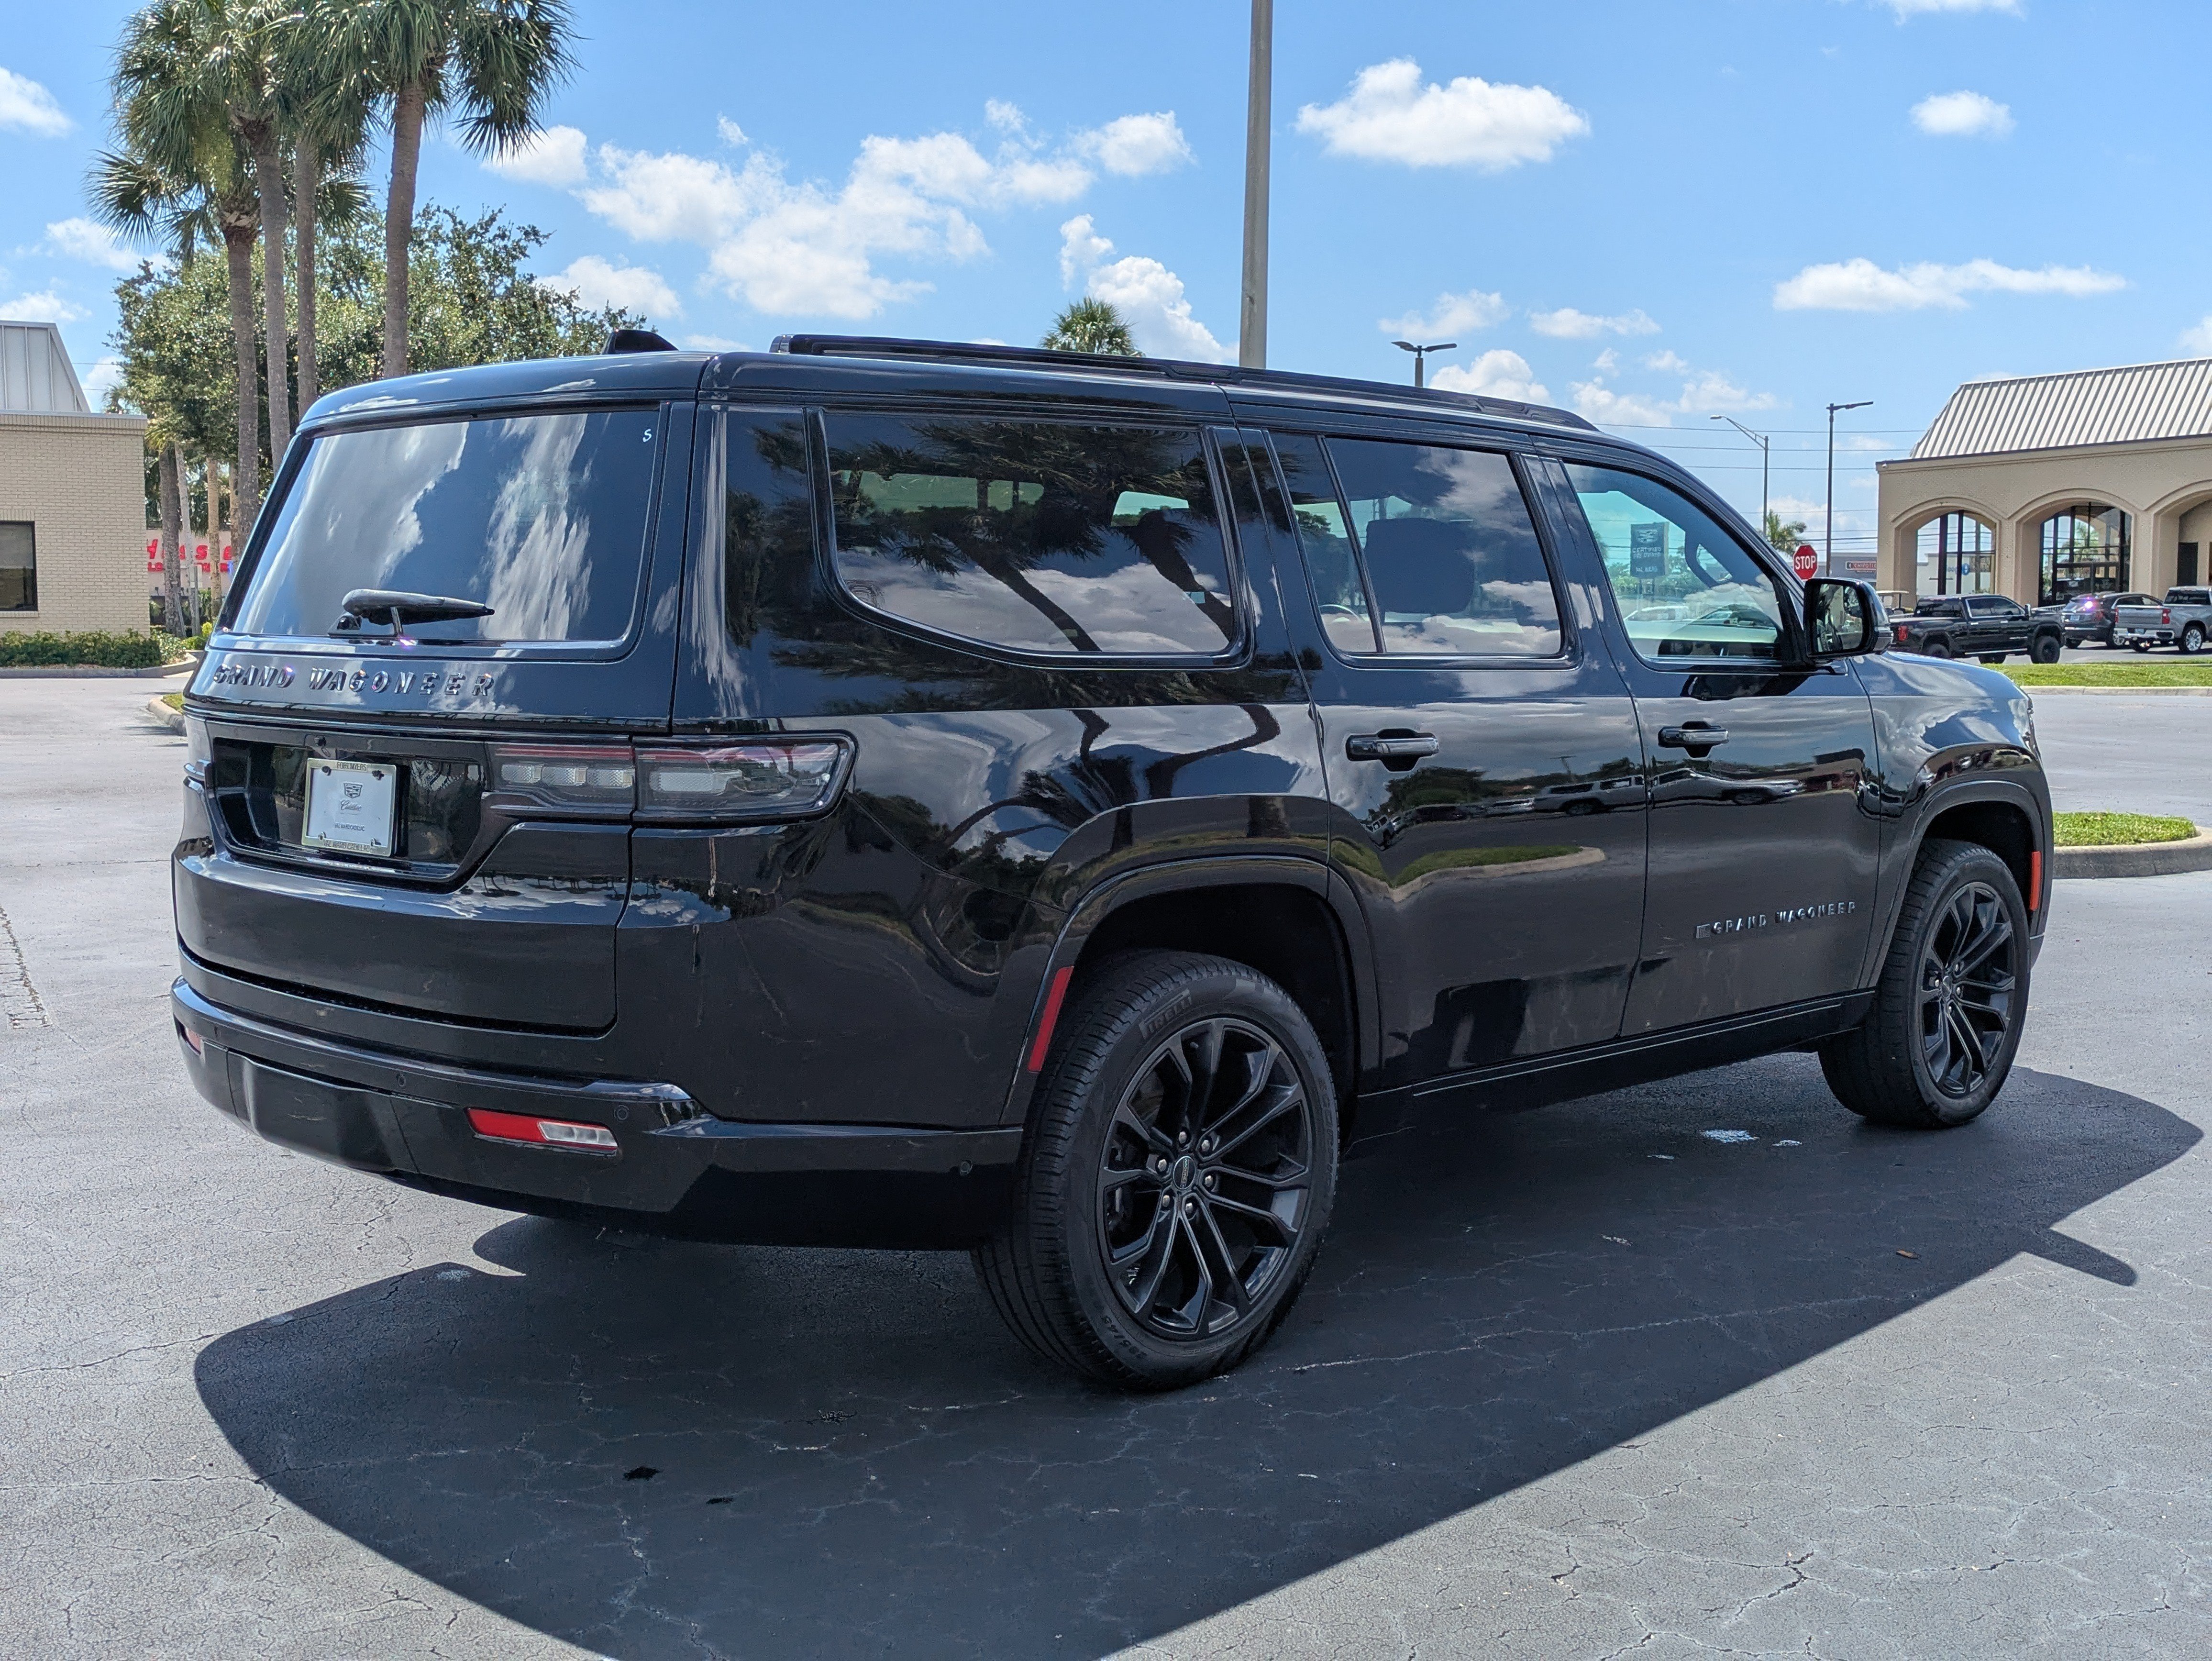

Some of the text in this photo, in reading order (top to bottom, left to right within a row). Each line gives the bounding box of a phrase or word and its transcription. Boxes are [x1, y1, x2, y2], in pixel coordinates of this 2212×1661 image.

[1795, 555, 1816, 570] STOP
[213, 663, 495, 697] GRAND WAGONEER
[336, 761, 367, 771] FORT MYERS
[1711, 901, 1856, 935] GRAND WAGONEER
[1139, 988, 1192, 1040] PIRELLI
